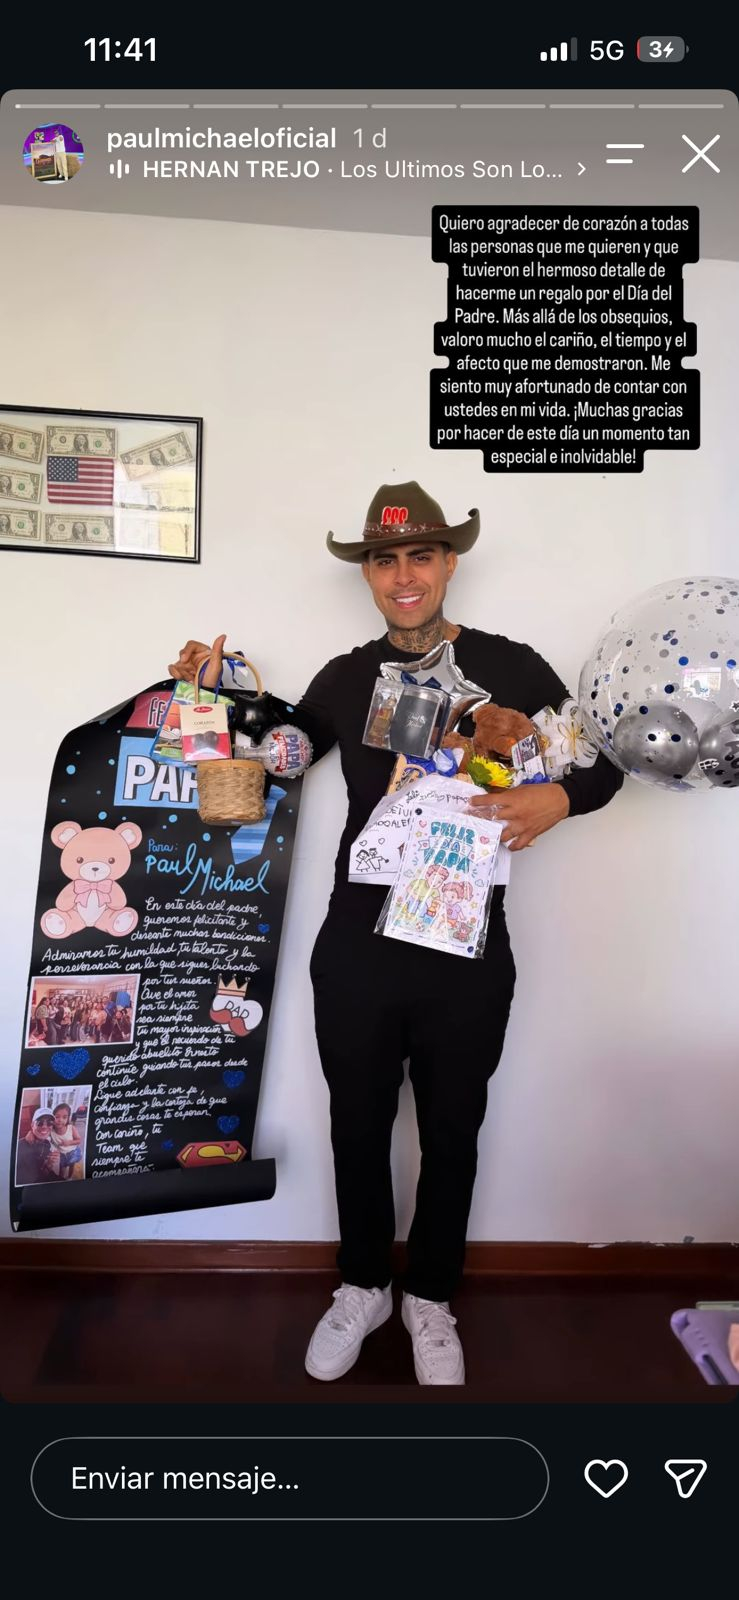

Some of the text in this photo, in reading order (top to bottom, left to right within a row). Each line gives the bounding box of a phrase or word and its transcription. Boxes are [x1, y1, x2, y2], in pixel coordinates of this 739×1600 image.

[146, 843, 270, 896] Paul Michael
[145, 896, 160, 910] En
[165, 899, 185, 910] este
[206, 900, 226, 911] del
[42, 948, 106, 962] Admiramos
[106, 944, 121, 955] tu
[179, 942, 191, 952] tu
[191, 941, 228, 954] talento
[241, 948, 256, 957] la
[125, 962, 143, 971] con
[144, 957, 158, 969] la
[160, 960, 177, 973] que
[142, 977, 160, 989] por
[141, 988, 161, 1000] Que
[156, 1001, 168, 1010] tu
[224, 1000, 249, 1018] DAD
[156, 1015, 193, 1024] siempre
[136, 1025, 148, 1035] tu
[224, 1034, 236, 1043] tu
[168, 1086, 185, 1095] con
[208, 1097, 228, 1109] que
[96, 1130, 113, 1140] Con
[152, 1123, 164, 1134] tu
[96, 1142, 148, 1156] Team que
